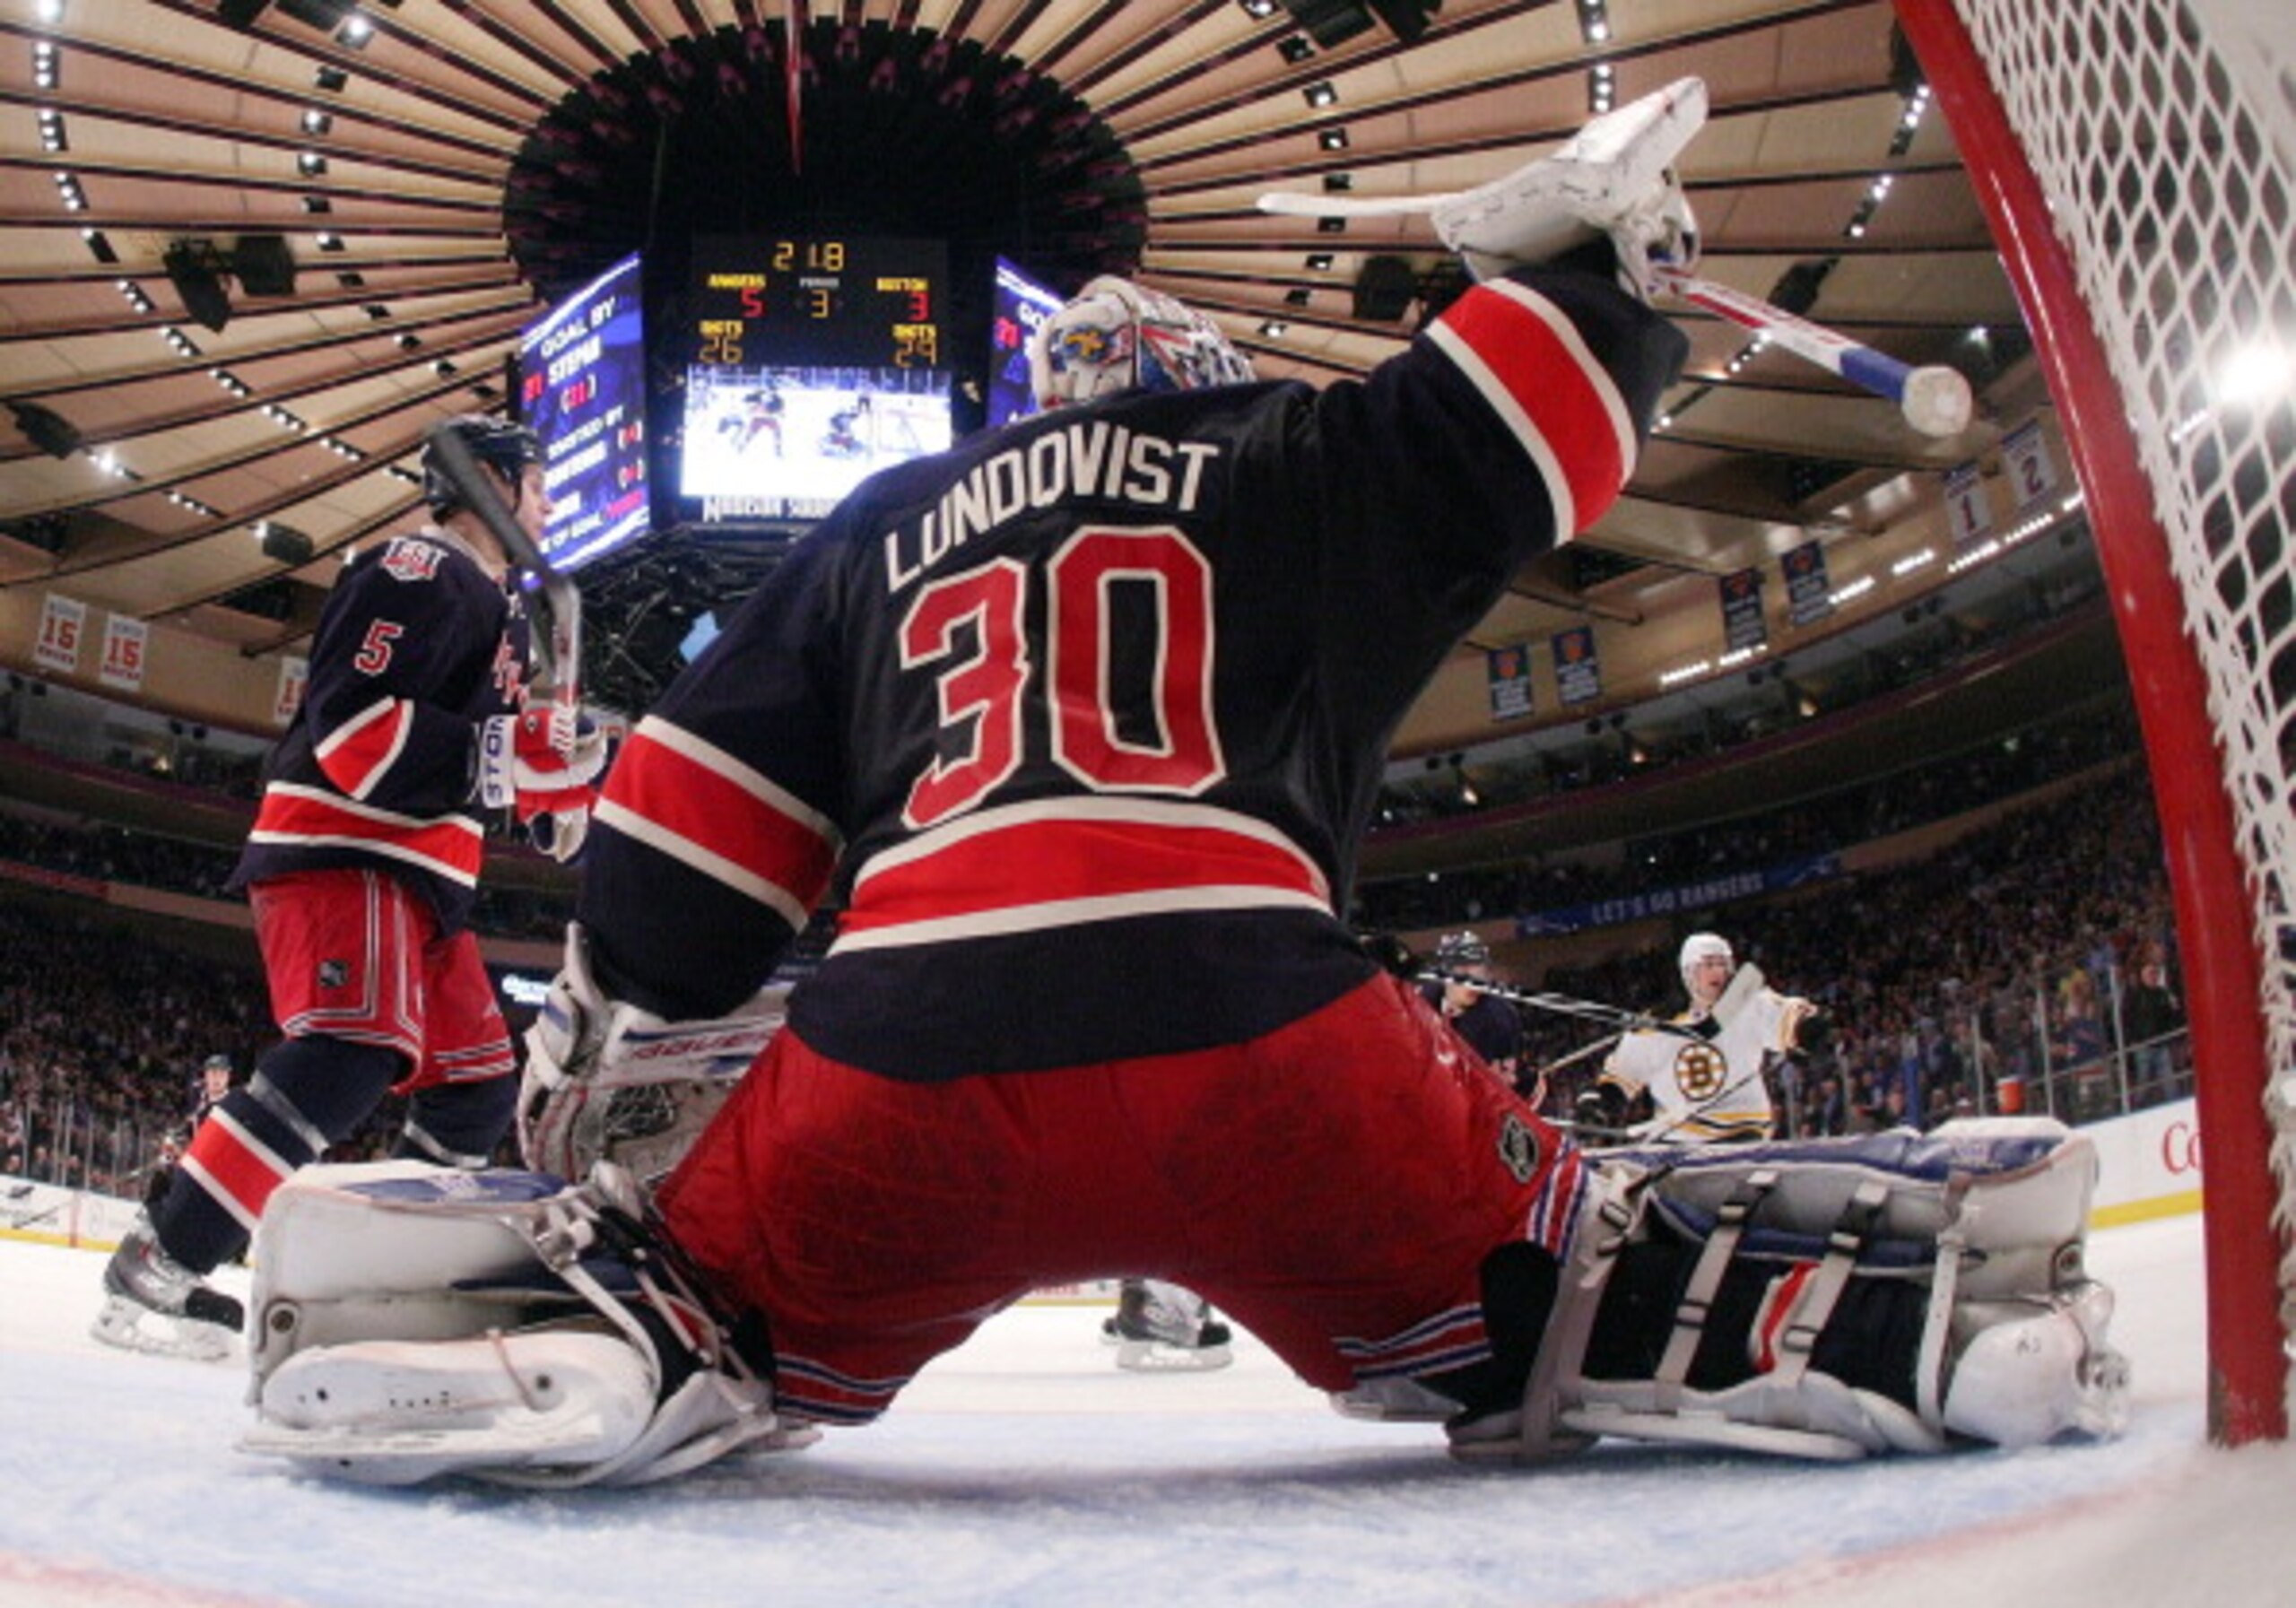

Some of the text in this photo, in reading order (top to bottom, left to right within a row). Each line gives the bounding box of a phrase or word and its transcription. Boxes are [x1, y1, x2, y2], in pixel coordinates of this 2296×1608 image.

[741, 287, 763, 318] 5
[811, 289, 830, 318] 3
[908, 291, 929, 322] 3
[2021, 455, 2044, 495] 2
[354, 619, 404, 675] 5
[899, 526, 1227, 830] 30
